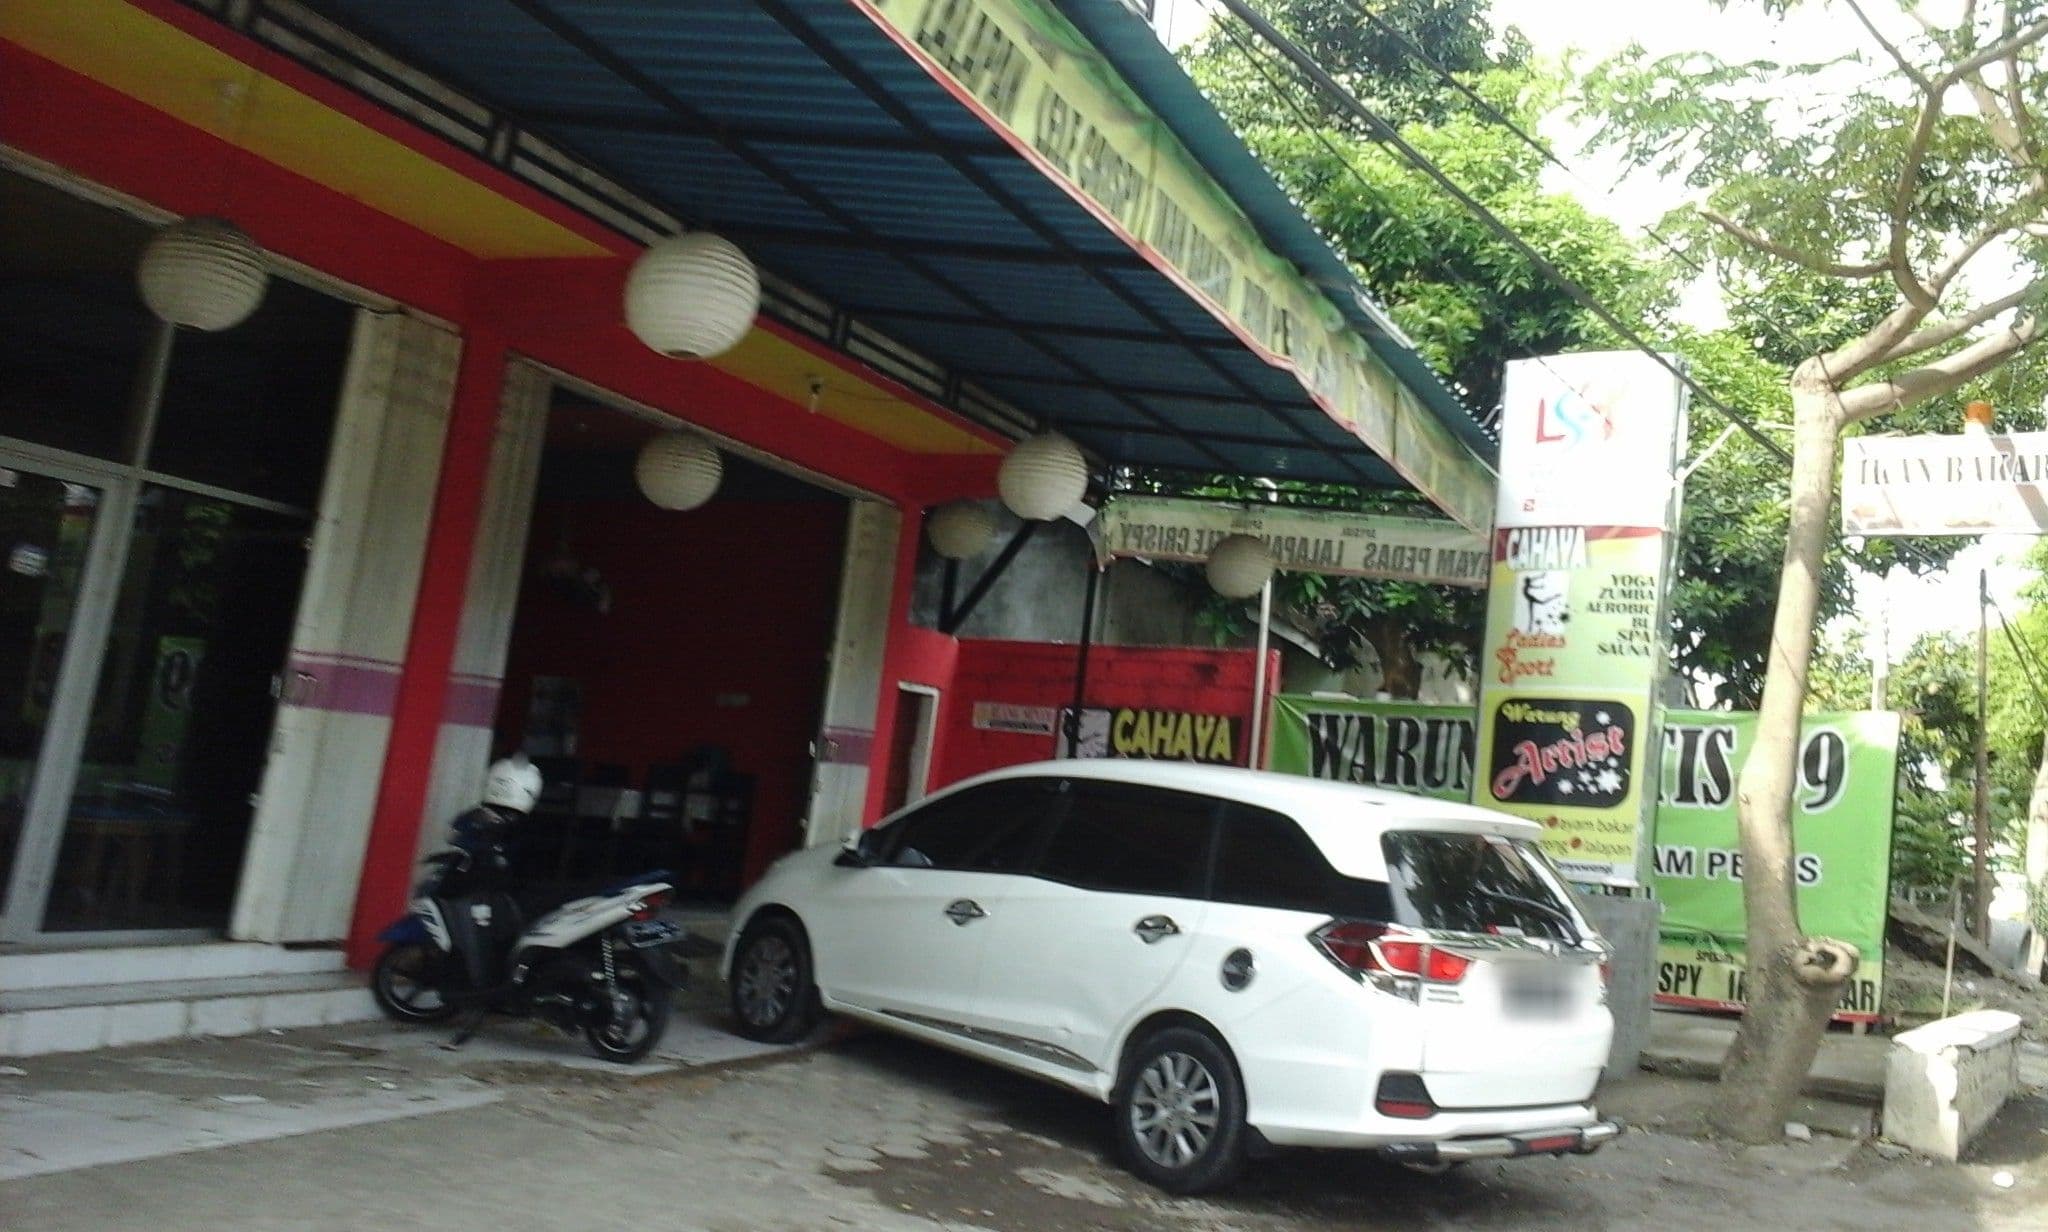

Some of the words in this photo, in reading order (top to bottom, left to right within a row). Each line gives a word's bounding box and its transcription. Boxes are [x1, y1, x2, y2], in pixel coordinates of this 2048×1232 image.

[1861, 457, 1931, 485] IKAN
[1506, 527, 1590, 570] CAHAYA
[1611, 574, 1655, 588] YOGA
[1599, 587, 1655, 600] ZUMBA
[1597, 643, 1650, 657] SAUNA
[1113, 708, 1233, 762] CAHAYA
